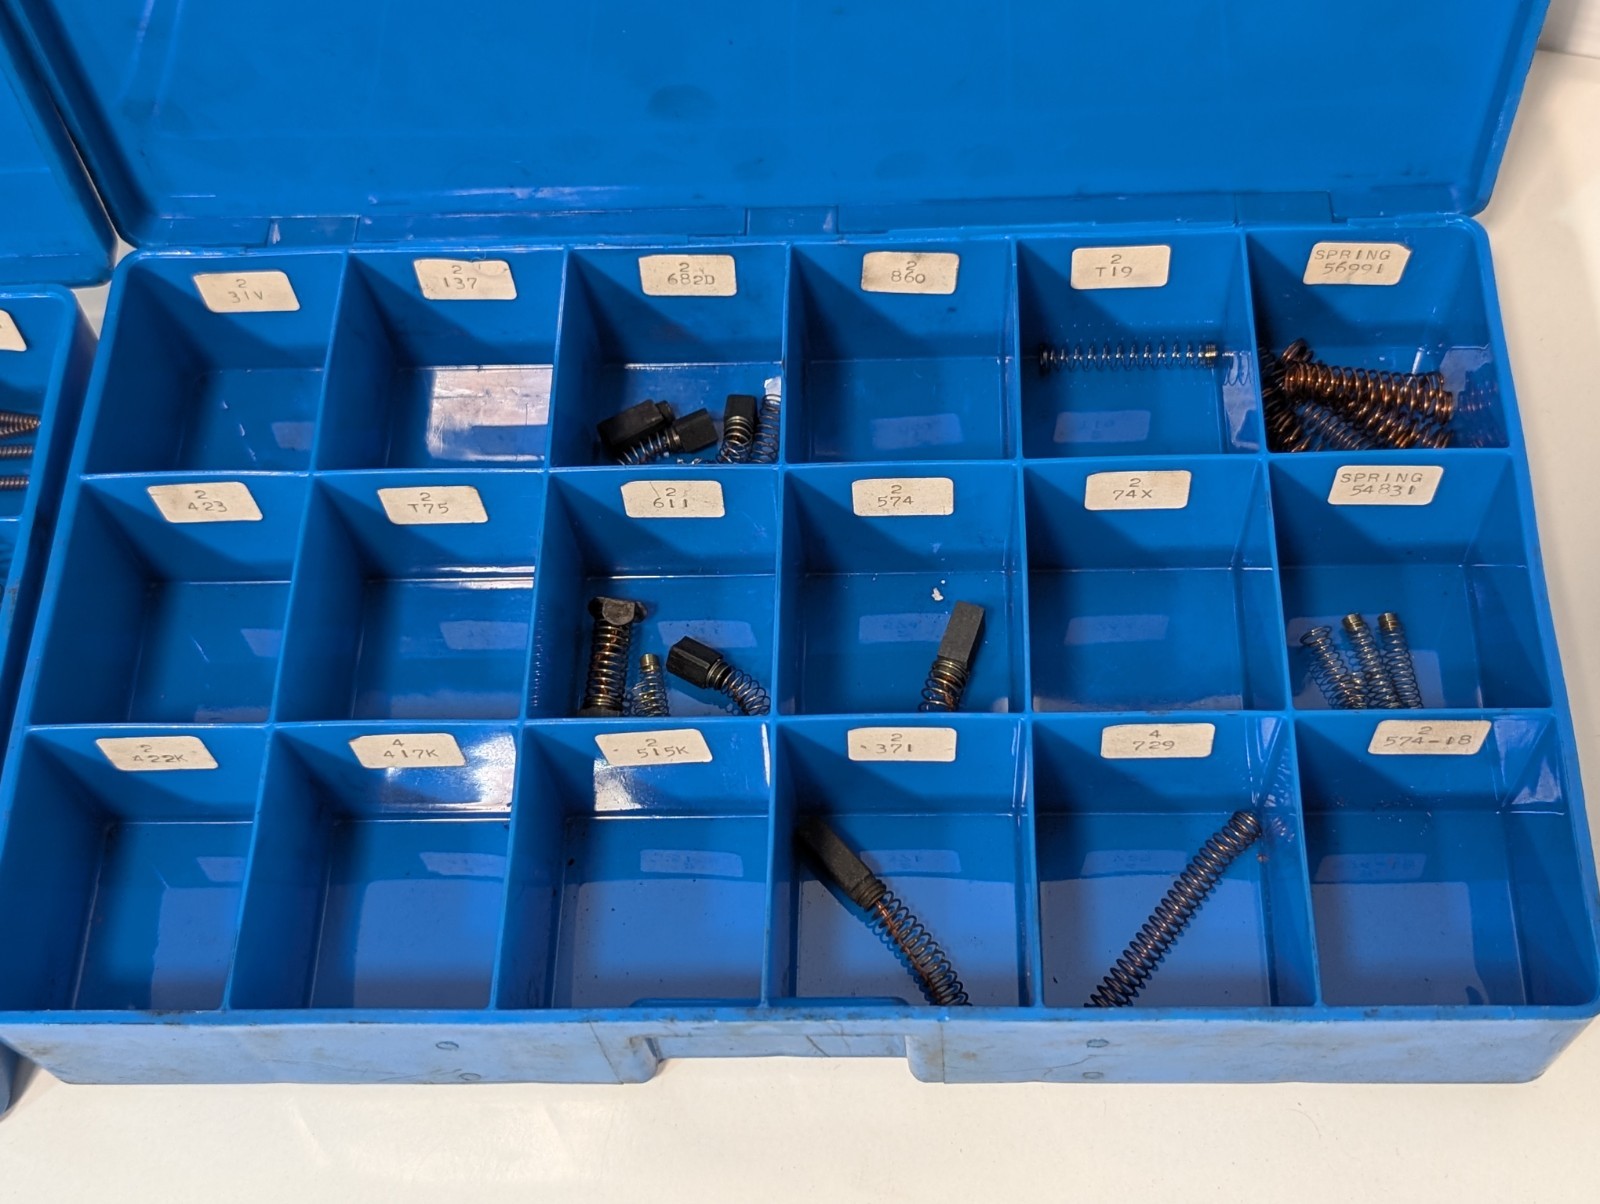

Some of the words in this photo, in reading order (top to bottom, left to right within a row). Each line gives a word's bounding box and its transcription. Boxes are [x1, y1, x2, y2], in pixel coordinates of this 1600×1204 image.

[1110, 254, 1121, 264] 2
[1314, 249, 1391, 261] SPRING
[451, 265, 463, 275] 2
[679, 262, 690, 273] 2
[906, 261, 918, 271] 2
[1322, 262, 1384, 275] 56991
[1094, 266, 1132, 278] T19
[236, 278, 248, 289] 2
[442, 277, 478, 290] 137
[667, 273, 715, 286] 682D
[1129, 477, 1142, 488] 2
[1339, 472, 1422, 484] SPRING
[194, 490, 207, 500] 2
[665, 487, 677, 497] 2
[890, 484, 902, 495] 2
[1112, 489, 1153, 501] 74X
[419, 492, 431, 502] 2
[653, 497, 688, 508] 611
[877, 495, 914, 507] 574
[187, 501, 228, 513] 423
[407, 502, 449, 514] T75
[1149, 729, 1161, 738] 4
[1419, 726, 1432, 735] 2
[392, 738, 405, 747] 4
[645, 738, 657, 747] 2
[890, 733, 903, 742] 2
[140, 744, 153, 753] 2
[876, 743, 912, 754] 371
[1132, 740, 1176, 751] 729
[383, 749, 439, 759] 417K
[637, 746, 690, 758] 515K
[132, 753, 187, 763] 422K
